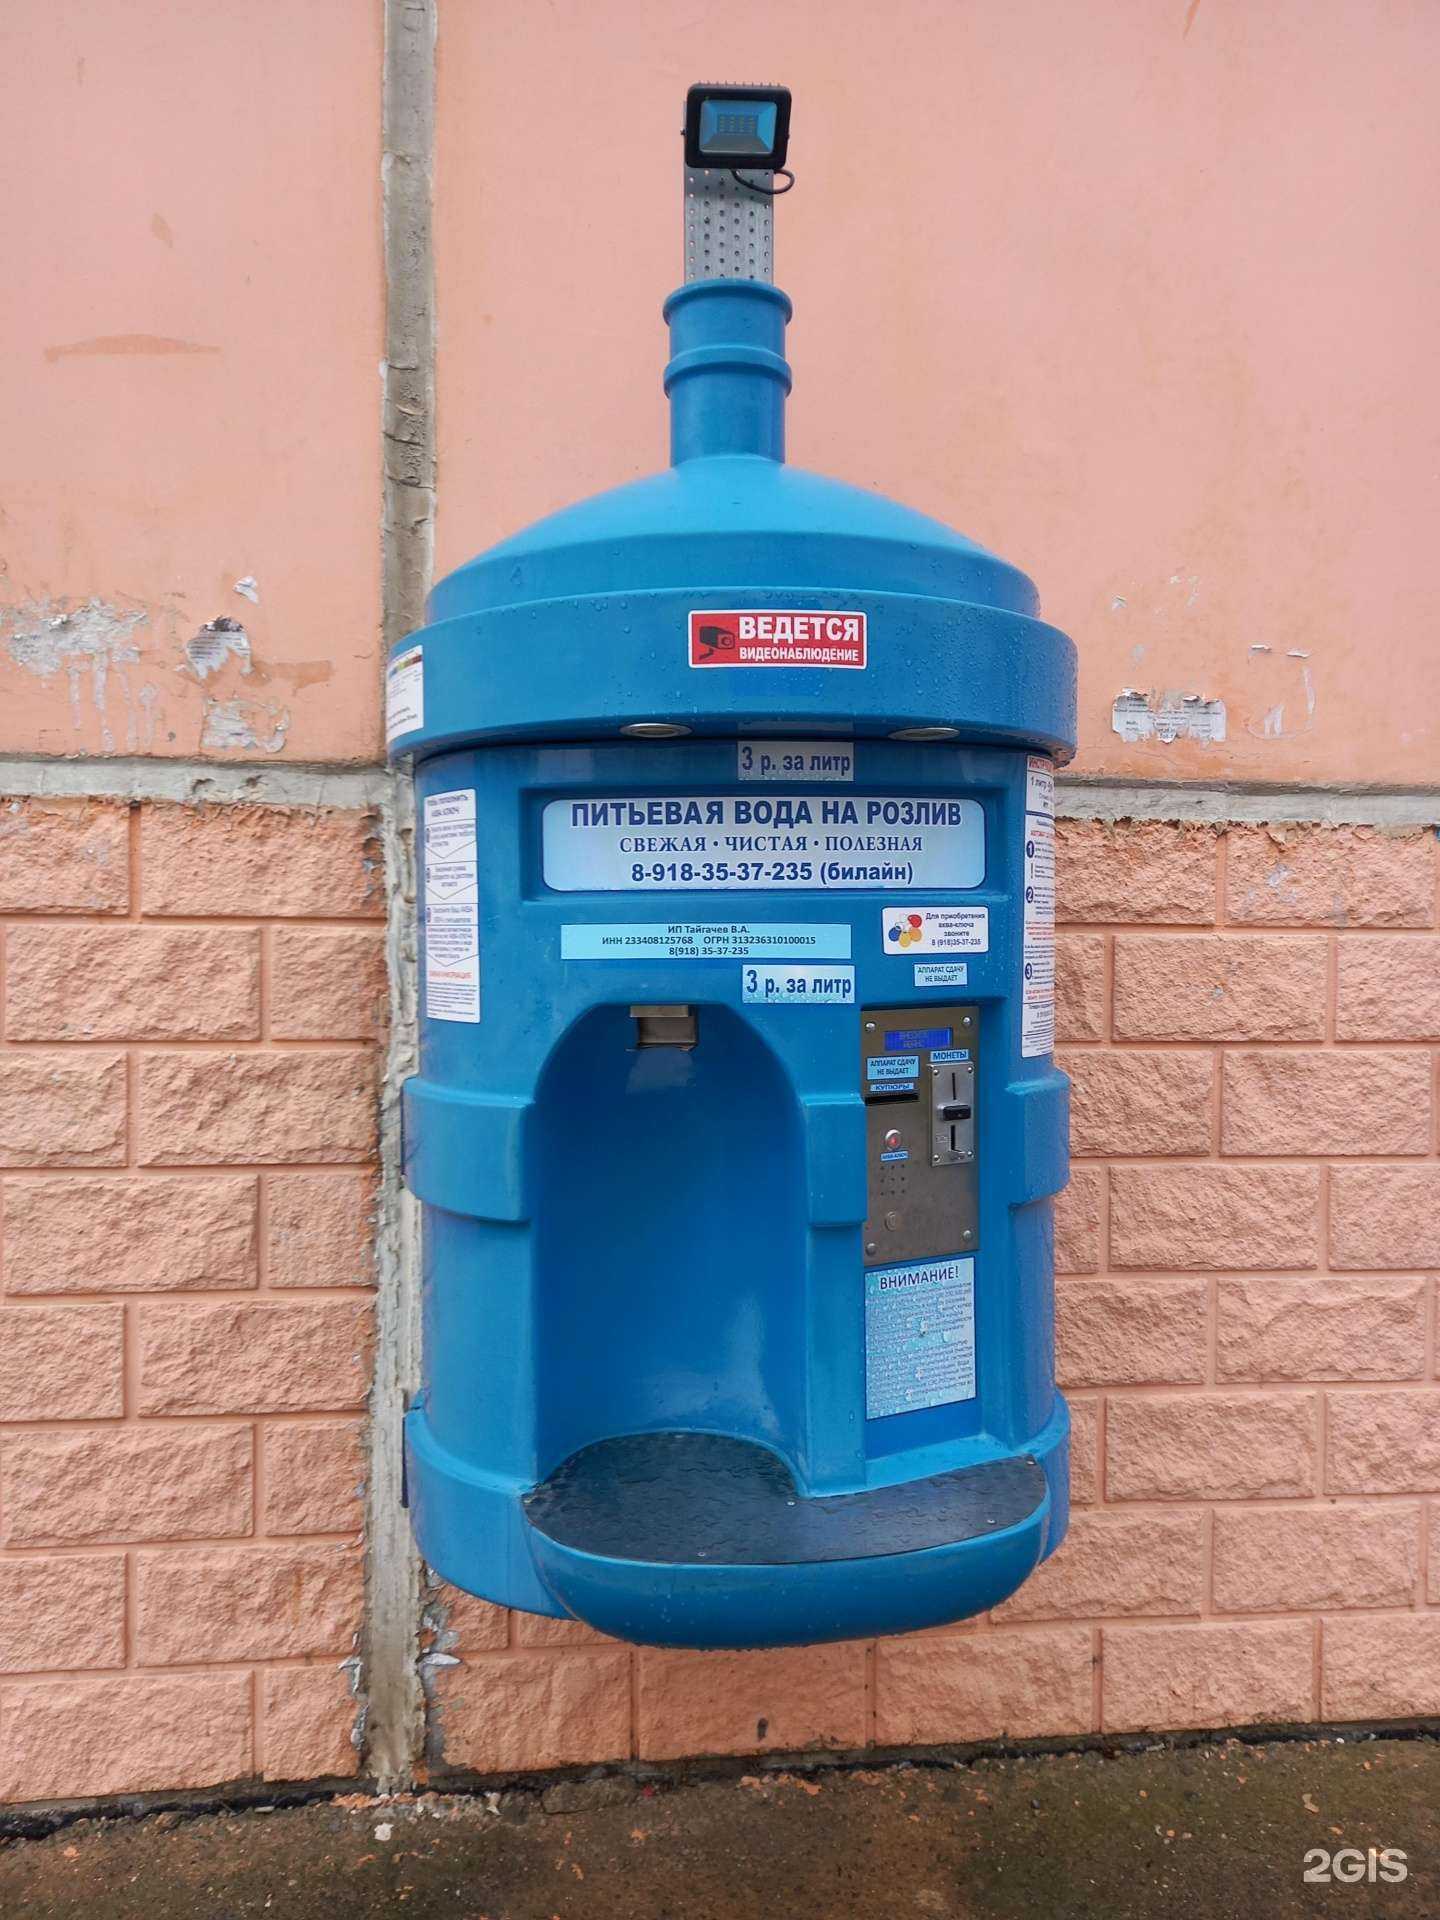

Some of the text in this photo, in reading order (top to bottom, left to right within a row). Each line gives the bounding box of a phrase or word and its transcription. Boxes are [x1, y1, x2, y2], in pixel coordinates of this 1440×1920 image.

[739, 616, 859, 643] ВЕДЕТСЯ
[739, 647, 859, 661] ВИДЕОНАБЛЮДЕНИЕ
[742, 747, 851, 775] 3 р. за литр
[572, 801, 962, 828] ПИТЬЕВАЯ ВОДА НА РОЗЛИВ
[620, 835, 922, 852] СВЕЖАЯ ЧИСТАЯ ПОЛЕЗНАЯ
[631, 862, 914, 883] 8-918-35-37-235 (билайн)
[668, 925, 682, 933] ИП
[685, 925, 729, 935] Тайгачев
[602, 937, 623, 945] ИНН
[625, 936, 694, 944] 233408125768
[703, 936, 729, 944] ОГРН
[669, 946, 749, 957] 8(918) 35-37-235
[917, 966, 944, 974] АППАРАТ
[746, 969, 851, 997] 3 р. за литр
[933, 1051, 966, 1060] МОНЕТЫ
[880, 1265, 959, 1290] ВНИМАНИЕ!
